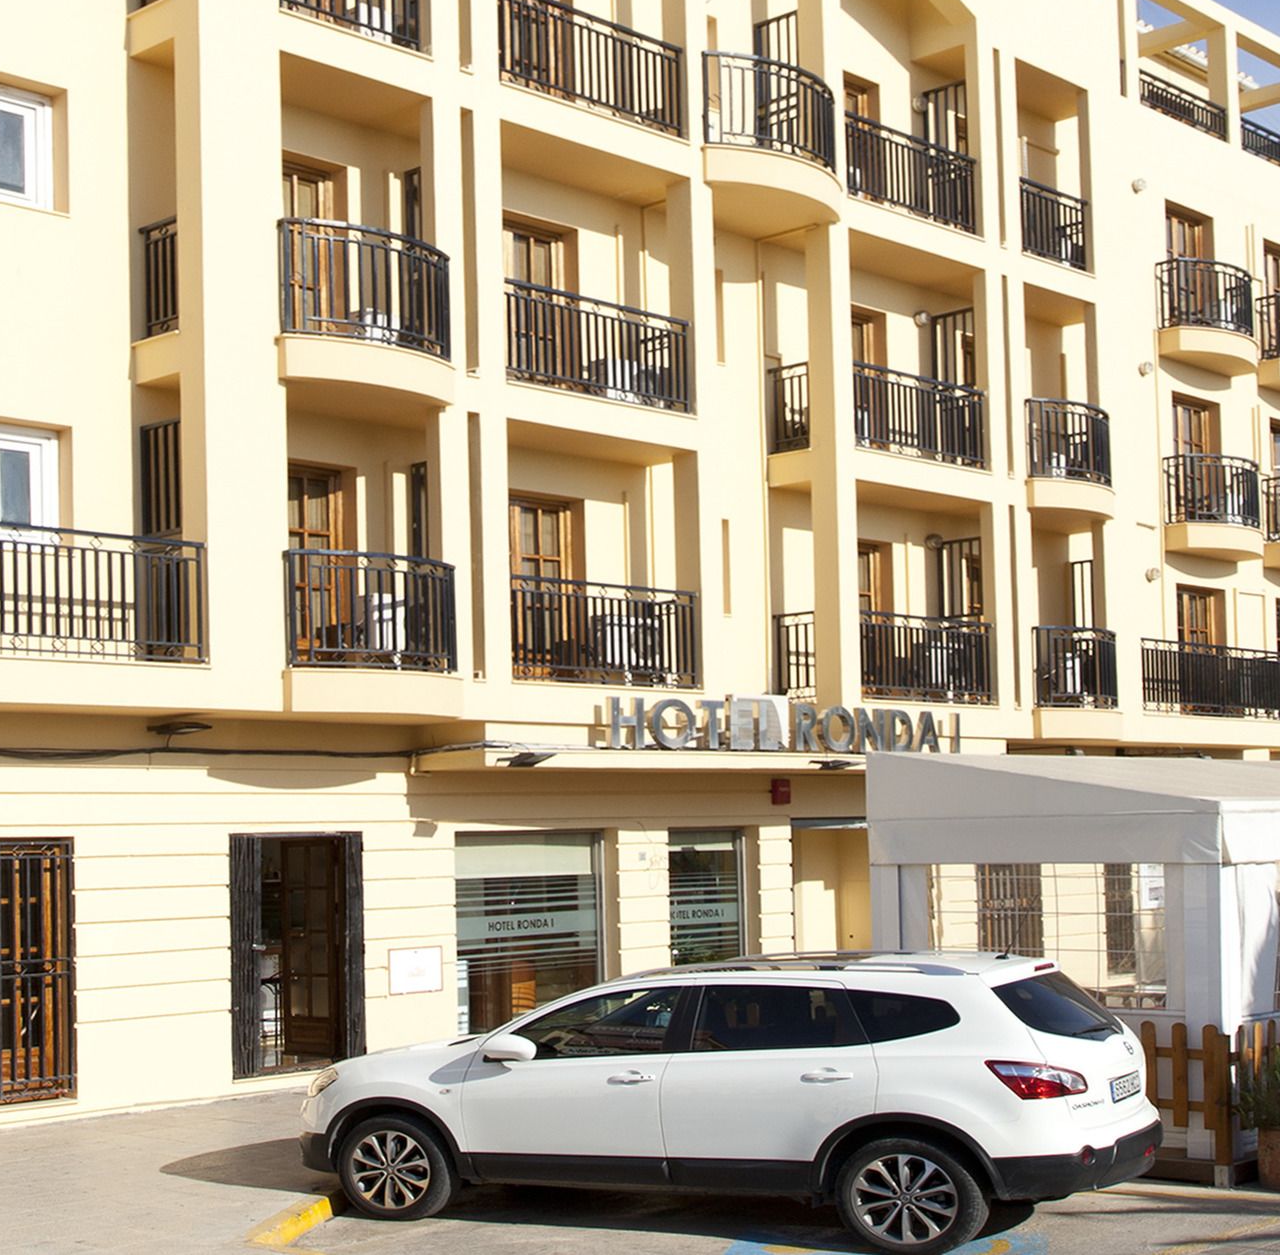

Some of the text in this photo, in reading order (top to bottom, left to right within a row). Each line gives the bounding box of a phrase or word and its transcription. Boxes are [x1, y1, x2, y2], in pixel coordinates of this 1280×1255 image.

[606, 695, 782, 750] HOTEL
[794, 703, 940, 753] RONDA
[692, 908, 720, 919] RONDA
[488, 920, 515, 932] HOTEL
[517, 918, 549, 930] RONDA
